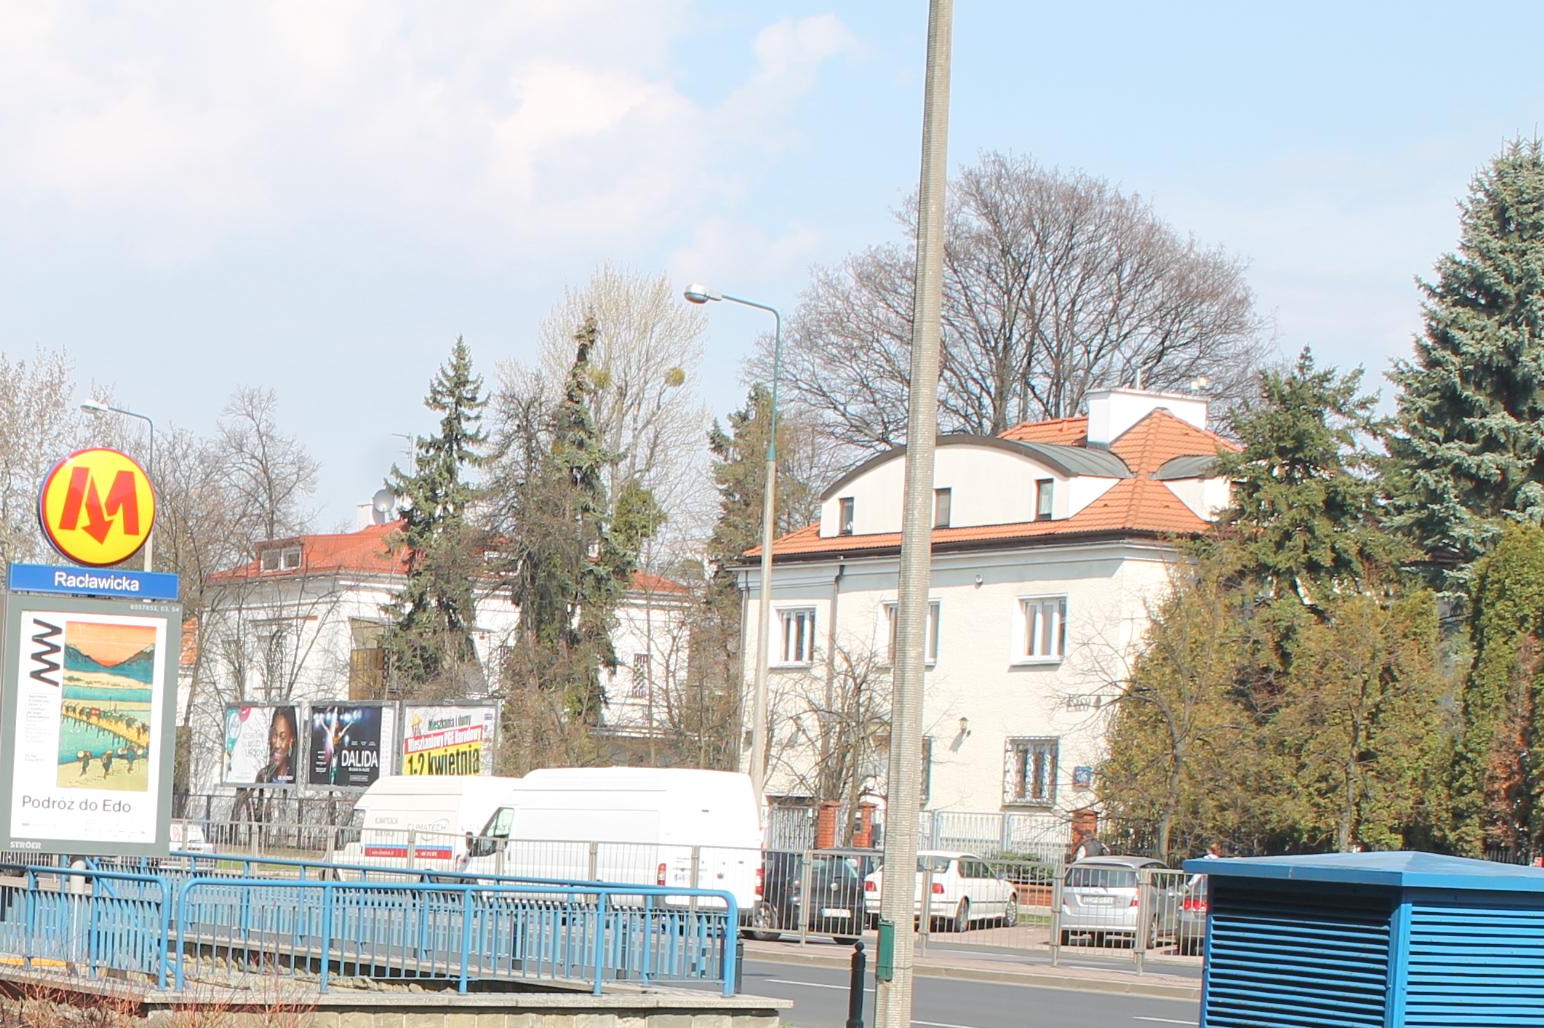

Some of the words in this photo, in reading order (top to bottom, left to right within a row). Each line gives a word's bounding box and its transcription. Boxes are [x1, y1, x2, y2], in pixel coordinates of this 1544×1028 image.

[59, 466, 140, 545] M
[54, 571, 140, 592] Racławicka
[341, 750, 379, 768] DALIDA
[428, 744, 480, 776] kwietnia
[79, 798, 98, 811] do
[102, 799, 132, 814] Edo
